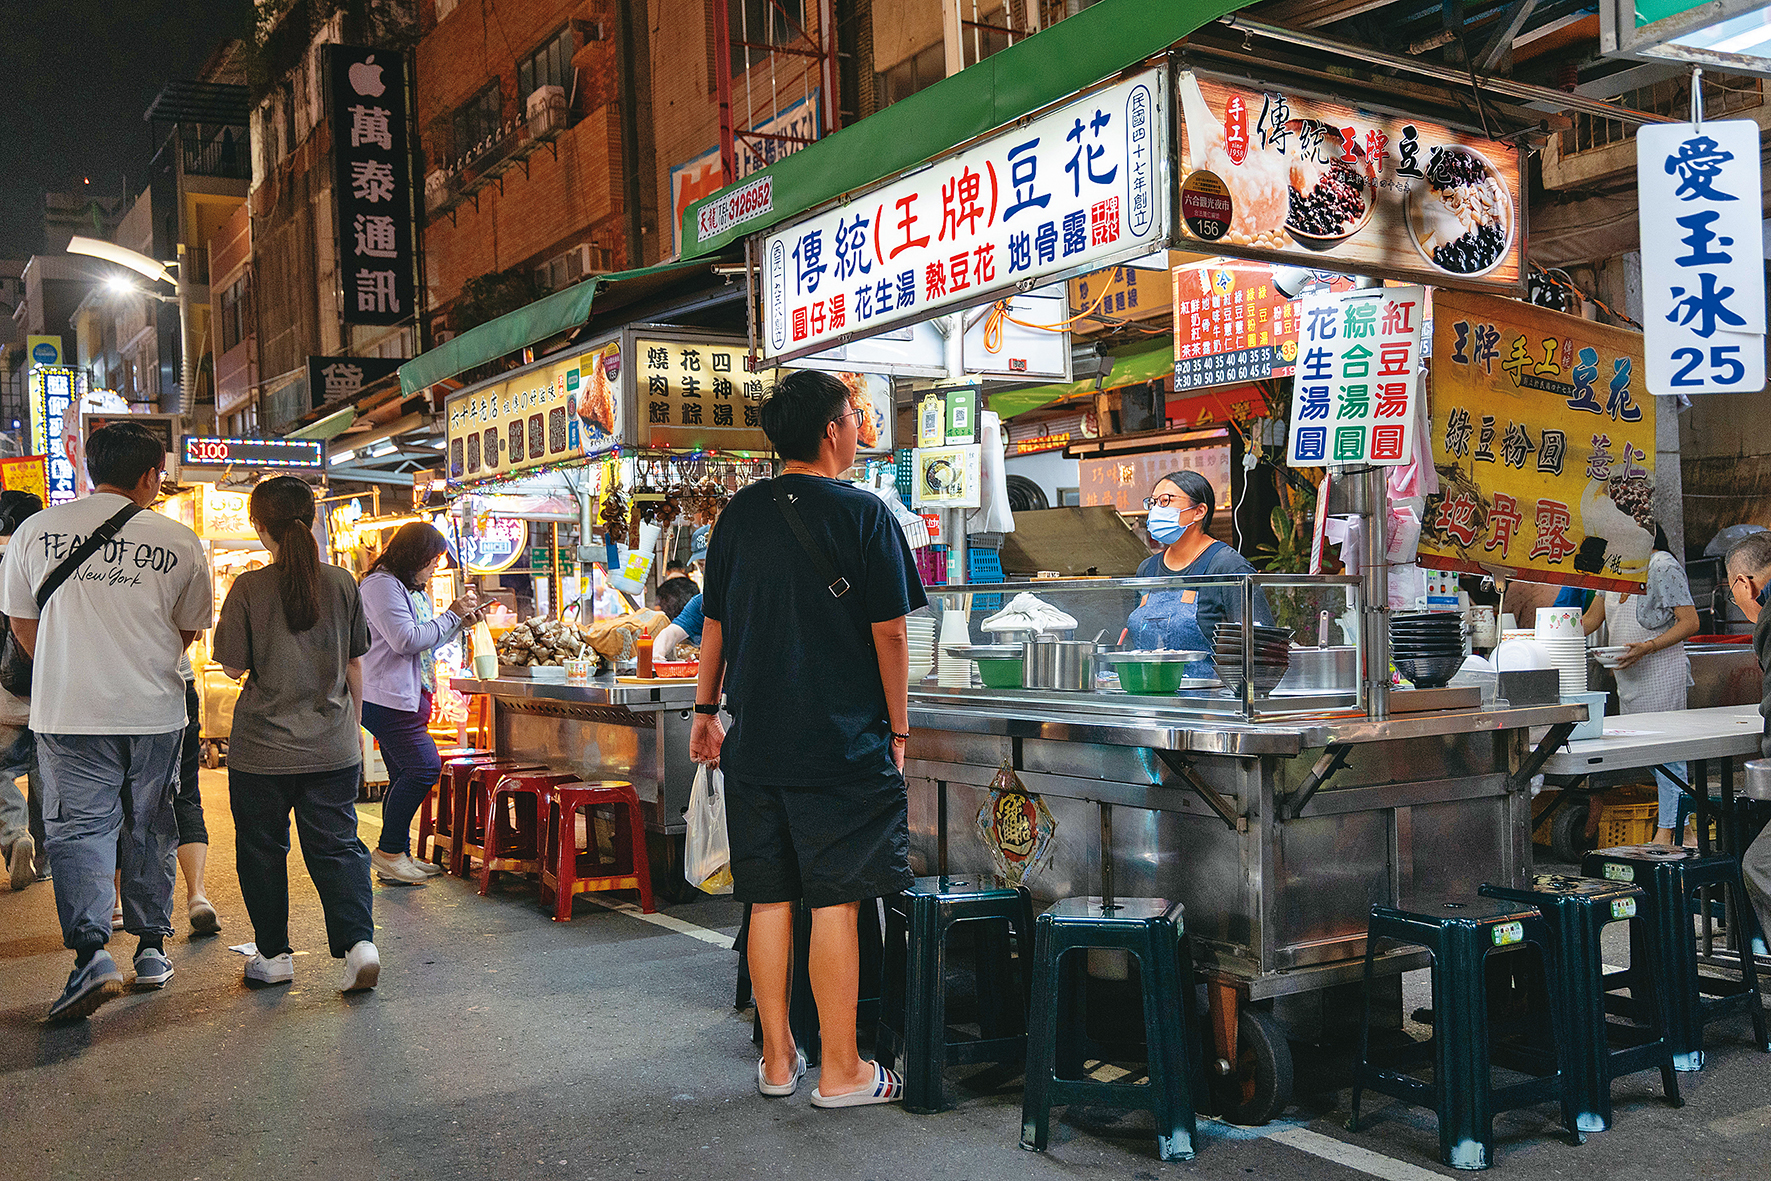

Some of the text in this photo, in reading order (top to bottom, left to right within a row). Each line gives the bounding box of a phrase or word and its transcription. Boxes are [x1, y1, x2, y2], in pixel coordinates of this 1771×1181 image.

[1228, 97, 1244, 142] 手工
[1131, 92, 1149, 228] 民國四十七年創立
[1230, 148, 1244, 158] 1958
[347, 104, 401, 314] 萬泰通訊
[718, 201, 729, 216] TEL
[728, 182, 770, 221] 3126952
[1184, 193, 1230, 212] 六合觀光夜市
[1197, 219, 1219, 237] 156
[1664, 134, 1748, 339] 愛玉冰
[792, 209, 1087, 342] 圓仔湯 花生湯 熱豆花 地骨露
[1216, 270, 1232, 291] 冷
[1180, 301, 1192, 358] 紅茶
[1190, 298, 1201, 357] 鮮奶紅茶
[1257, 284, 1269, 346] 綠豆湯
[647, 345, 671, 425] 燒肉粽
[680, 349, 703, 426] 花生粽
[1192, 359, 1201, 372] 35
[1203, 357, 1213, 370] 40
[1215, 355, 1224, 368] 35
[1226, 353, 1236, 367] 40
[1237, 351, 1248, 365] 40
[1249, 350, 1259, 363] 35
[1261, 347, 1271, 361] 35
[1283, 343, 1296, 355] 35
[1193, 373, 1203, 386] 50
[1204, 371, 1214, 385] 50
[1215, 369, 1225, 383] 50
[1226, 368, 1236, 381] 60
[1238, 366, 1248, 380] 60
[1250, 364, 1260, 378] 45
[1261, 362, 1271, 376] 45
[1294, 305, 1338, 461] 花生湯圓
[1333, 301, 1378, 461] 綜合湯圓
[1370, 300, 1416, 460] 紅豆湯圓
[1451, 320, 1643, 423] 王牌 手工 豆花
[1669, 345, 1746, 388] 25
[450, 390, 499, 431] 六十年老店
[711, 352, 735, 428] 四神湯
[742, 349, 766, 428] 噌湯
[198, 442, 229, 459] 100
[1444, 405, 1648, 482] 綠豆粉圓 薏仁
[38, 531, 179, 575] FEA OF GOD
[1433, 485, 1578, 565] 地骨露
[73, 563, 142, 588] New York
